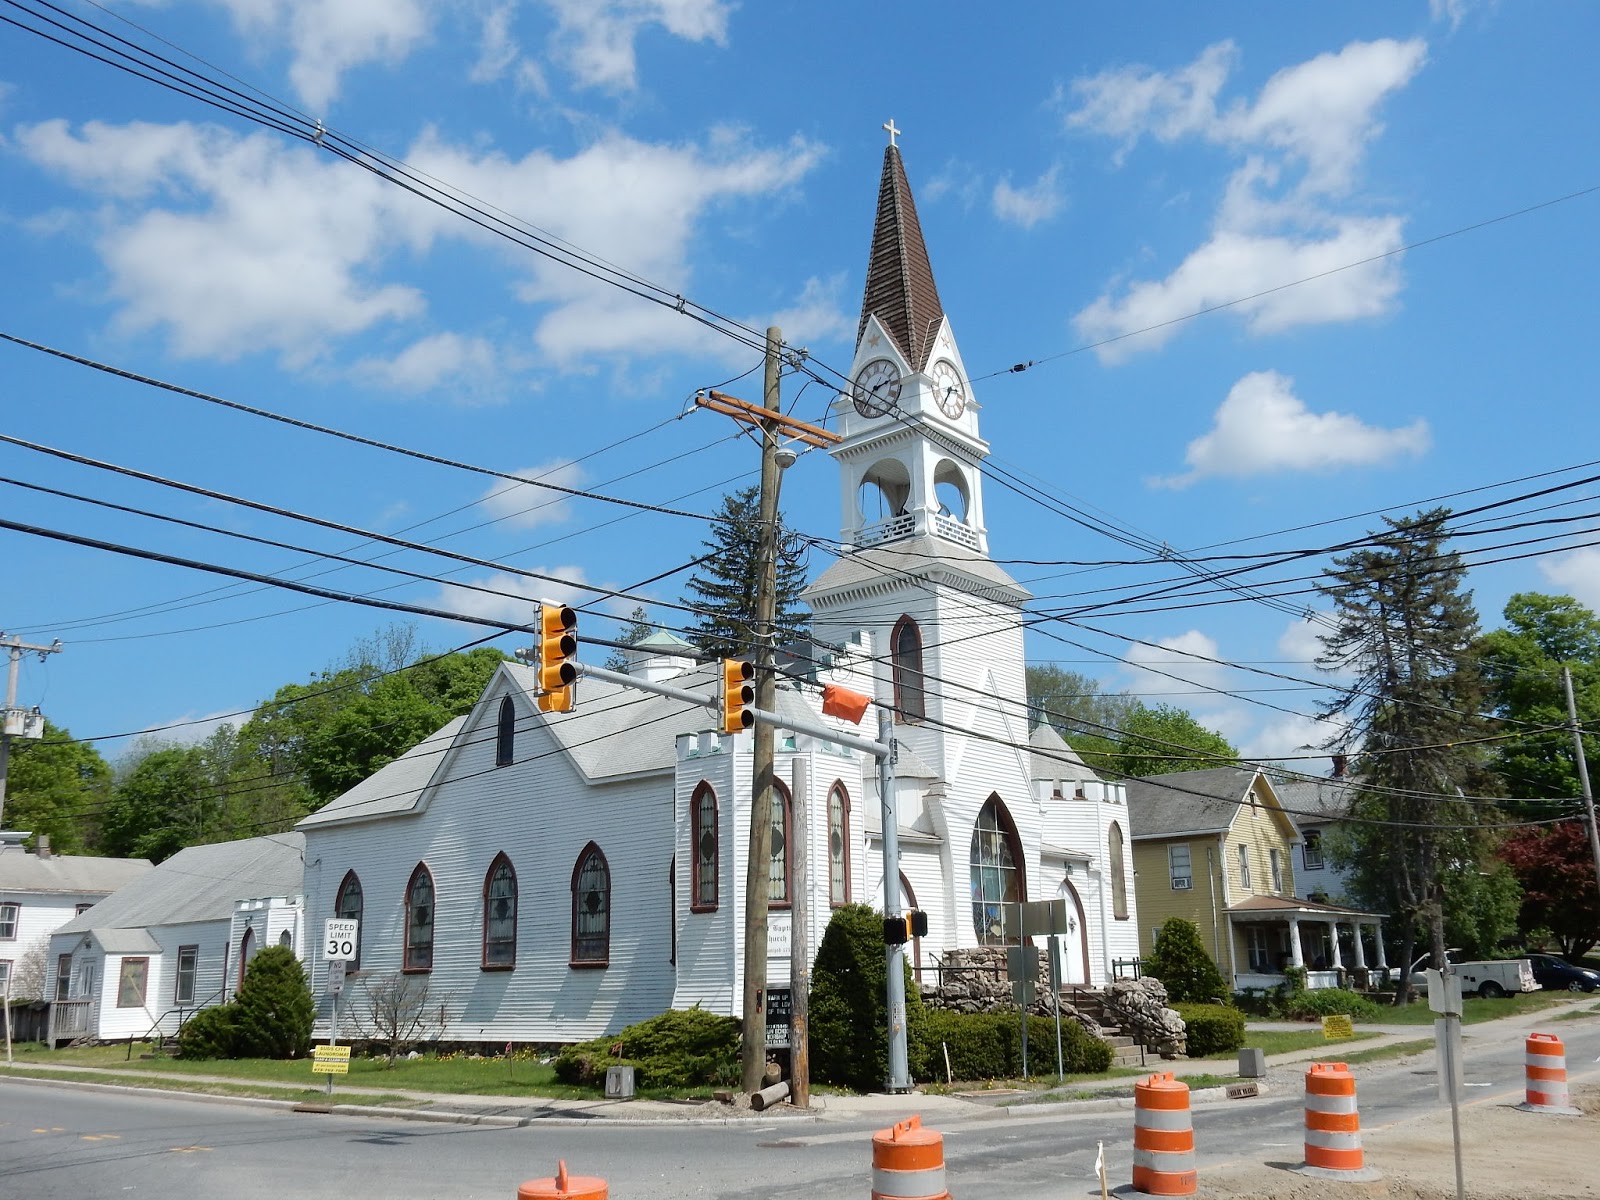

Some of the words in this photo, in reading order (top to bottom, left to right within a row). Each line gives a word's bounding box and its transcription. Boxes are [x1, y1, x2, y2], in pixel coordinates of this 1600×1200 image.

[328, 923, 355, 931] SPEED
[330, 931, 352, 939] LIMIT
[768, 935, 786, 943] hurch
[327, 940, 353, 955] 30
